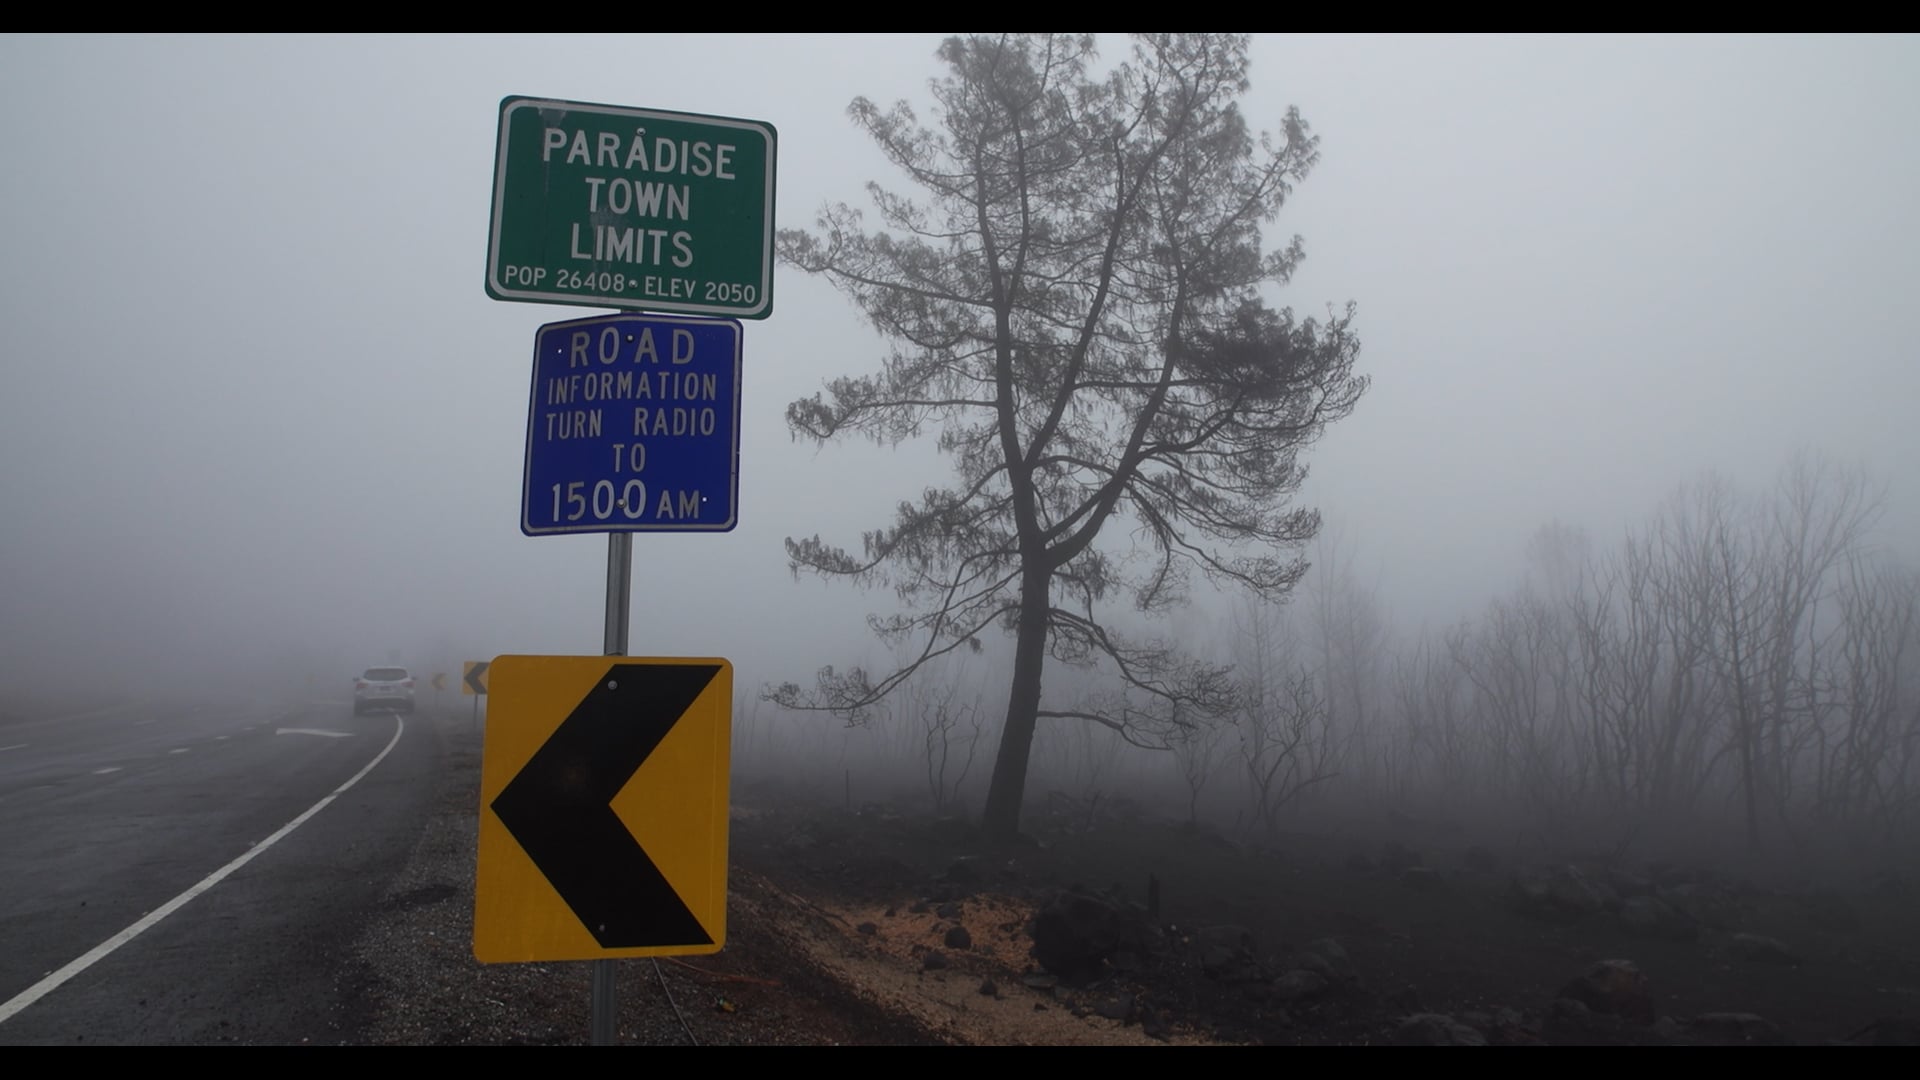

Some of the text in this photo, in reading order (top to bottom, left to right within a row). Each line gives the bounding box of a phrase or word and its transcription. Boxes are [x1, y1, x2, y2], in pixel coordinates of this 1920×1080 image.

[543, 128, 736, 180] PARADISE
[585, 177, 690, 221] TOWN
[571, 223, 693, 268] LIMITS
[505, 265, 756, 304] POP 26408 ELEV 2050
[570, 327, 695, 368] ROAD
[548, 371, 717, 405] INFORMATION
[546, 407, 715, 441] TURN RADIO
[613, 443, 646, 473] TO
[552, 479, 700, 522] 1500 AM
